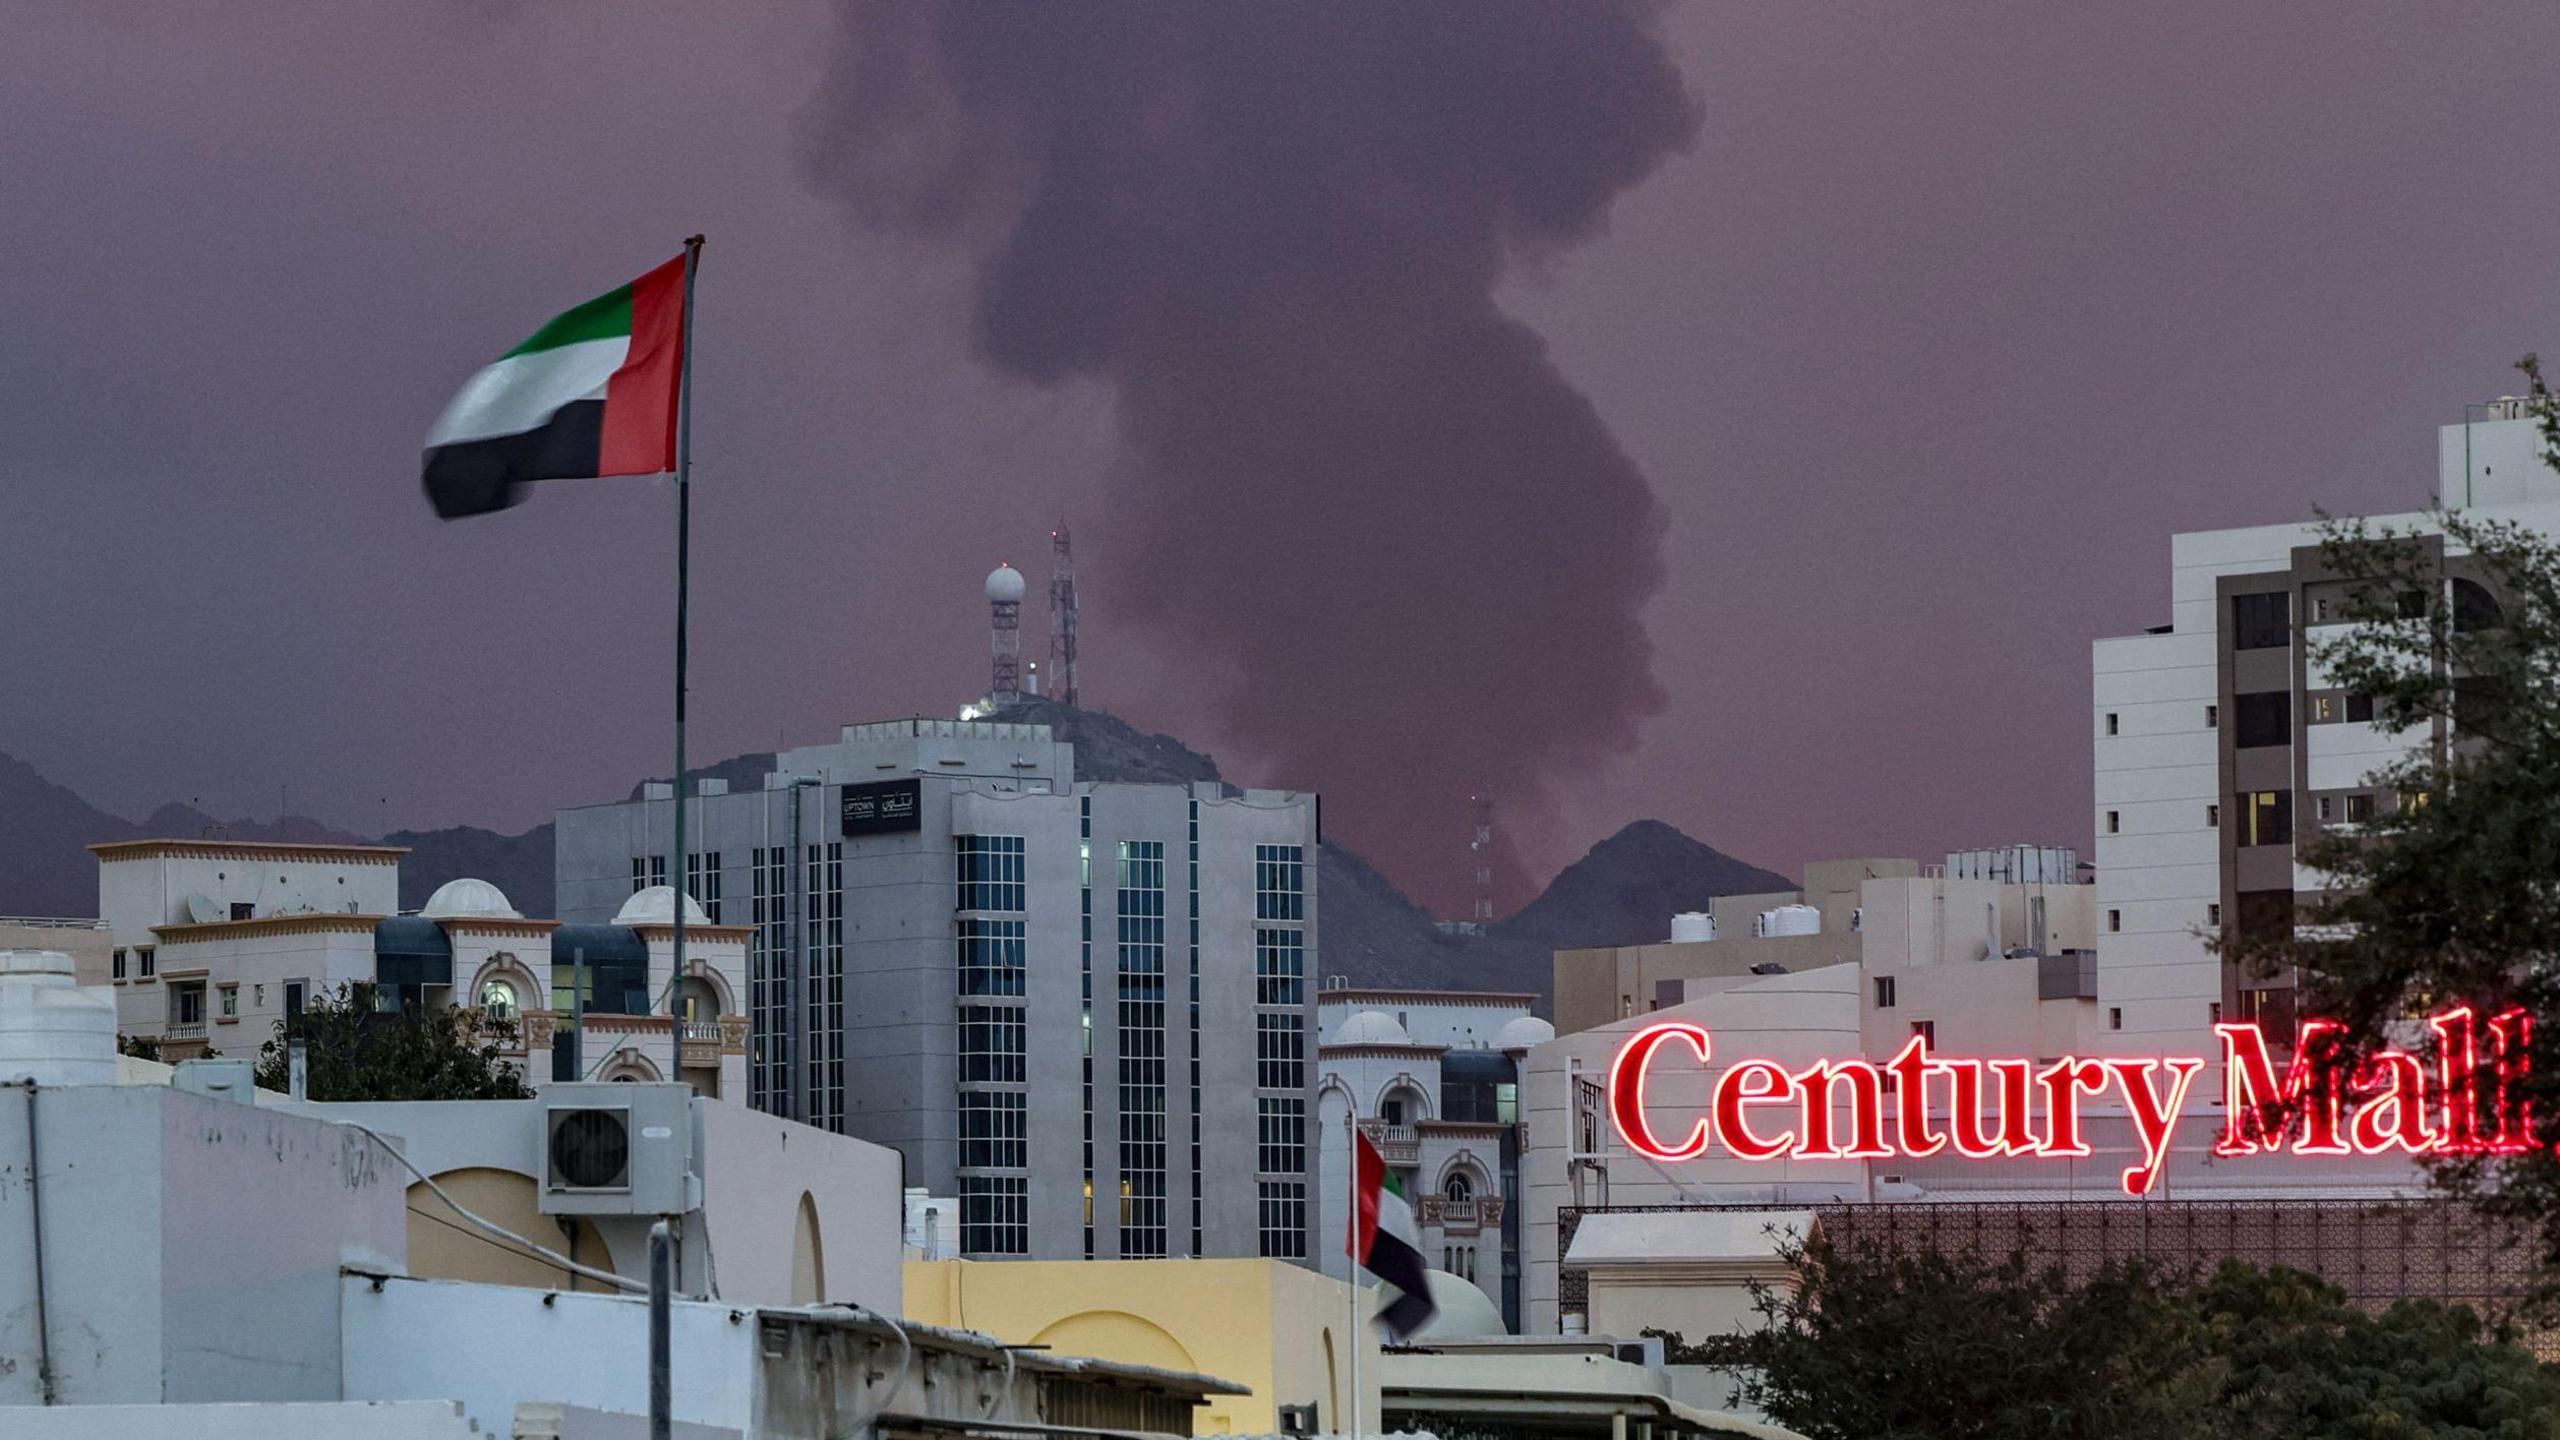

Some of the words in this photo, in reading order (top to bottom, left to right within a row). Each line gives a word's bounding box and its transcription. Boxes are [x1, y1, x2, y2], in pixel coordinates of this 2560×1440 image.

[844, 800, 875, 812] UPTOWN
[1610, 1022, 2205, 1195] Century
[2214, 1007, 2544, 1154] Mall
